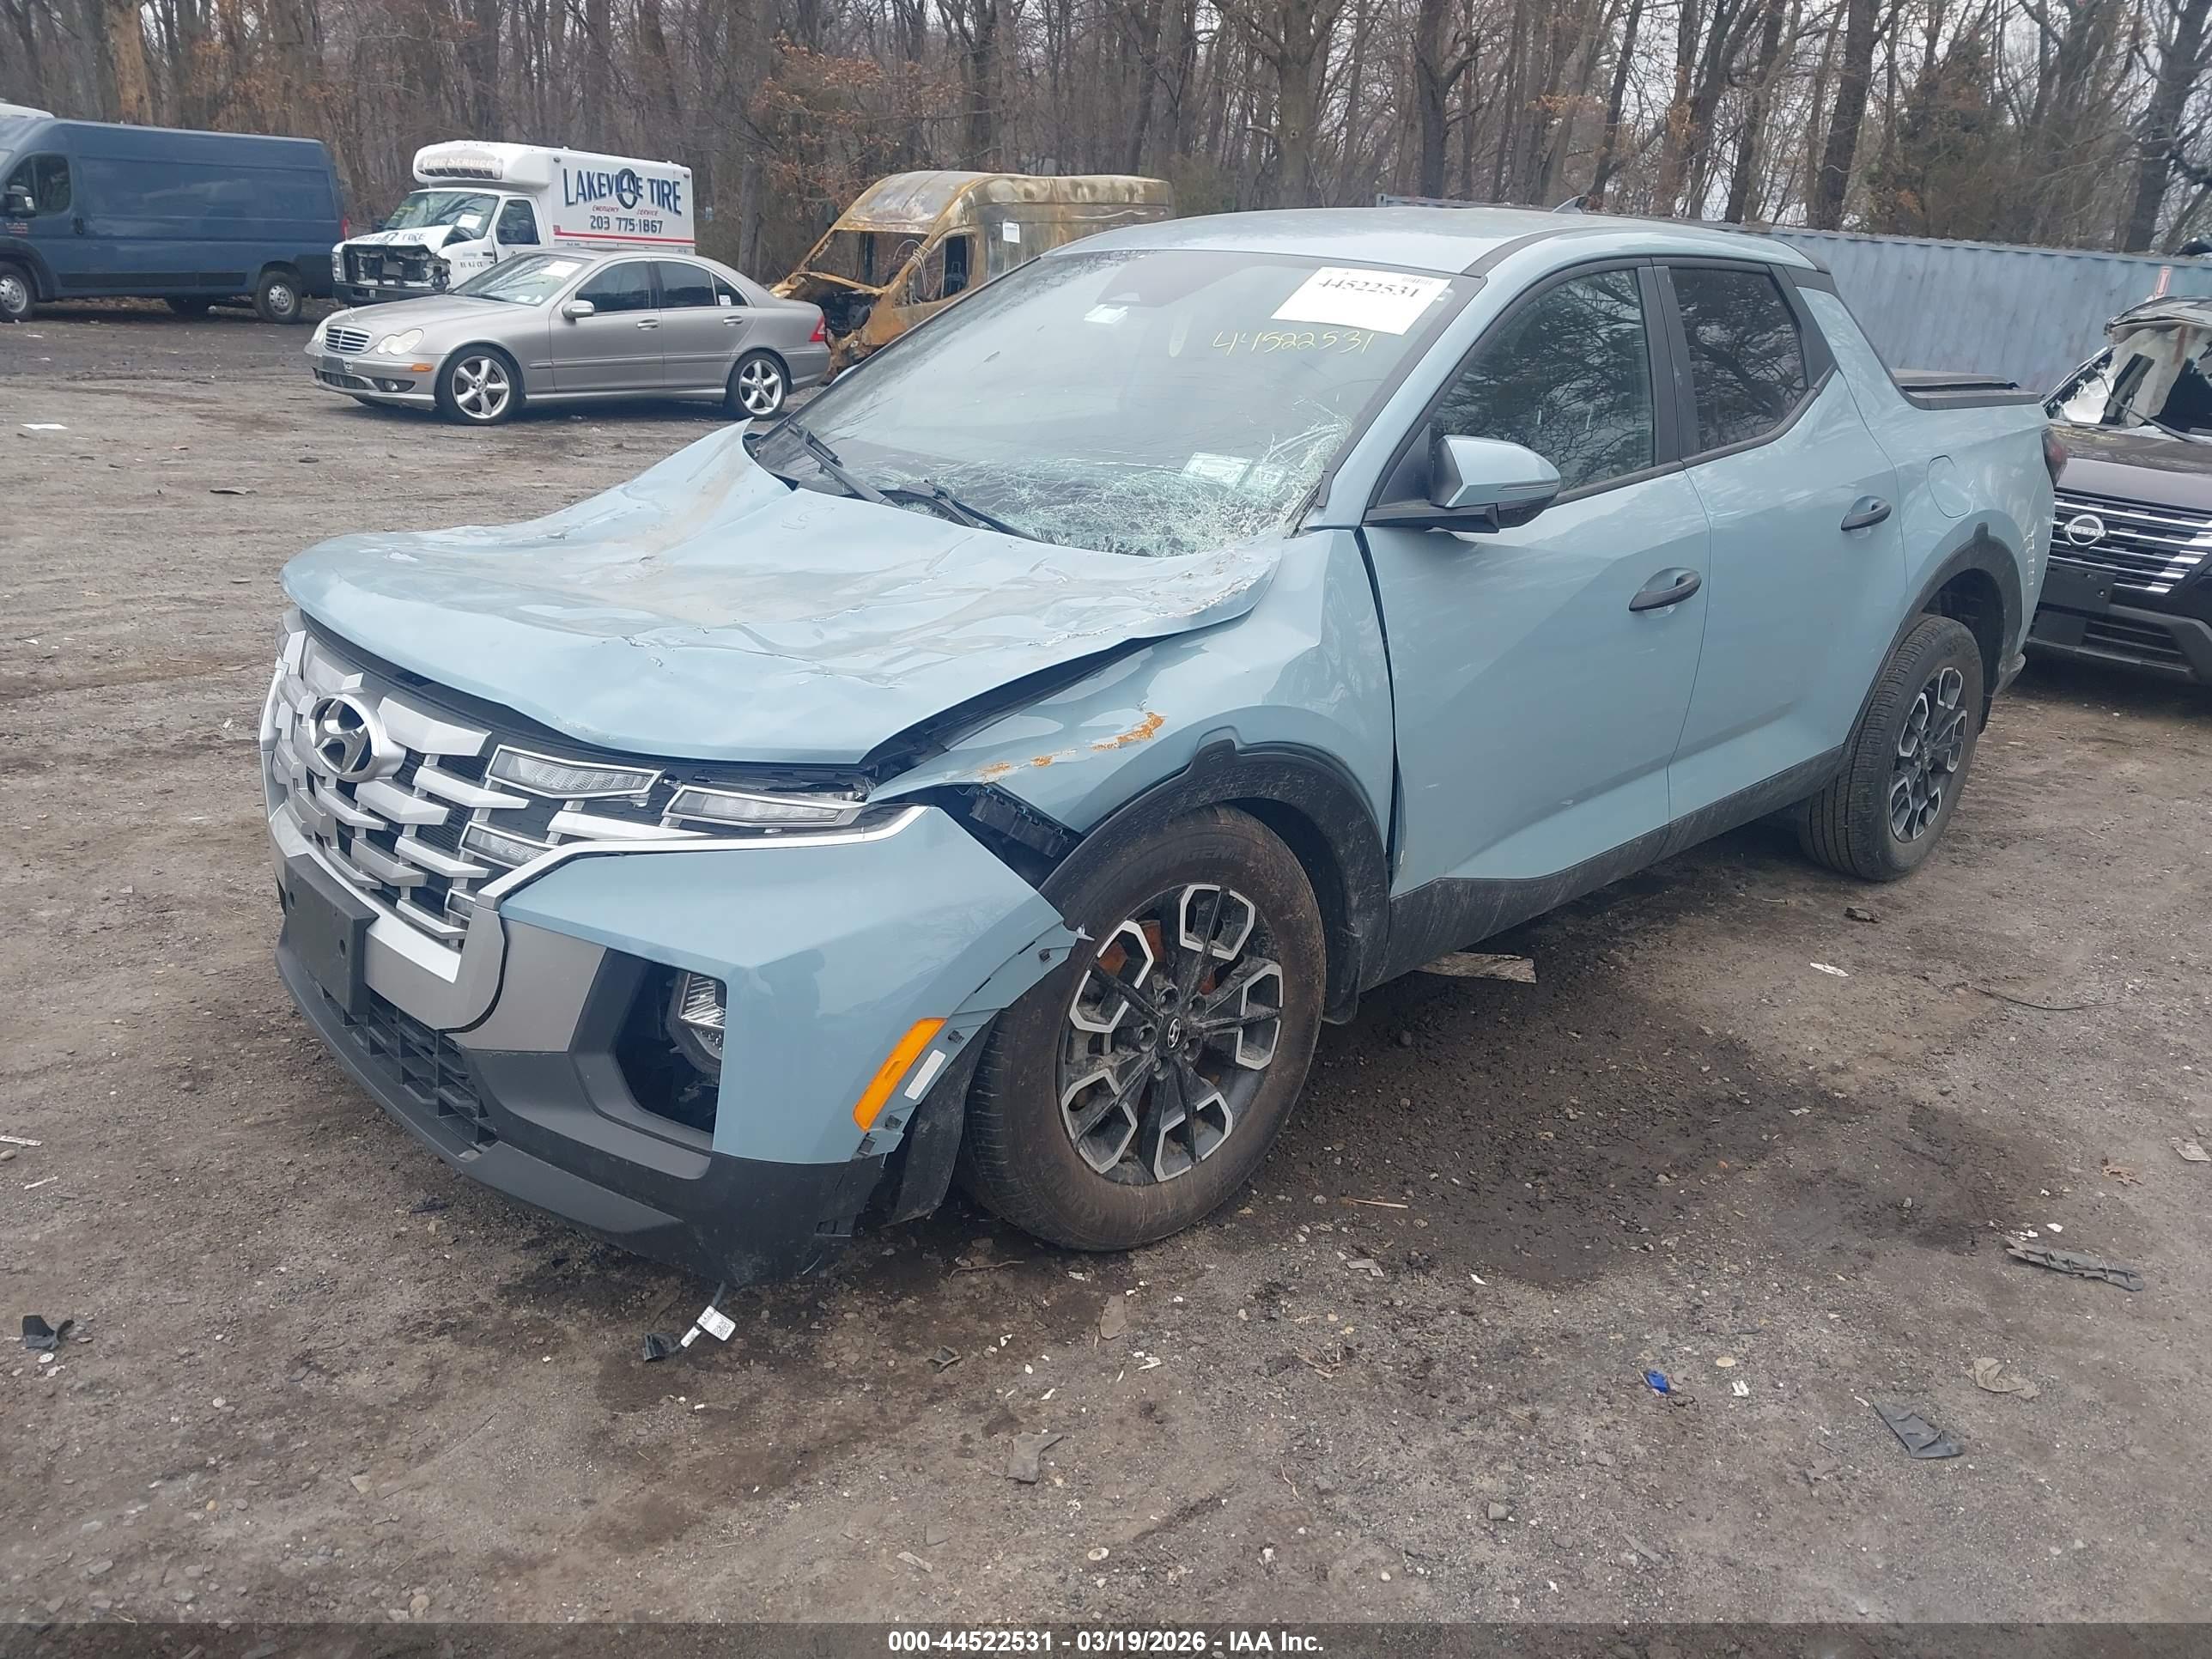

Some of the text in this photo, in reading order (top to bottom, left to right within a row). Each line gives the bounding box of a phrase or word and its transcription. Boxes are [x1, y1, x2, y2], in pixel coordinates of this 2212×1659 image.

[563, 167, 682, 216] LAKEVILLE TIRE
[590, 215, 611, 230] 203
[1318, 278, 1420, 298] 44522531
[1212, 330, 1374, 356] 44522531
[2063, 524, 2107, 538] NISSAN
